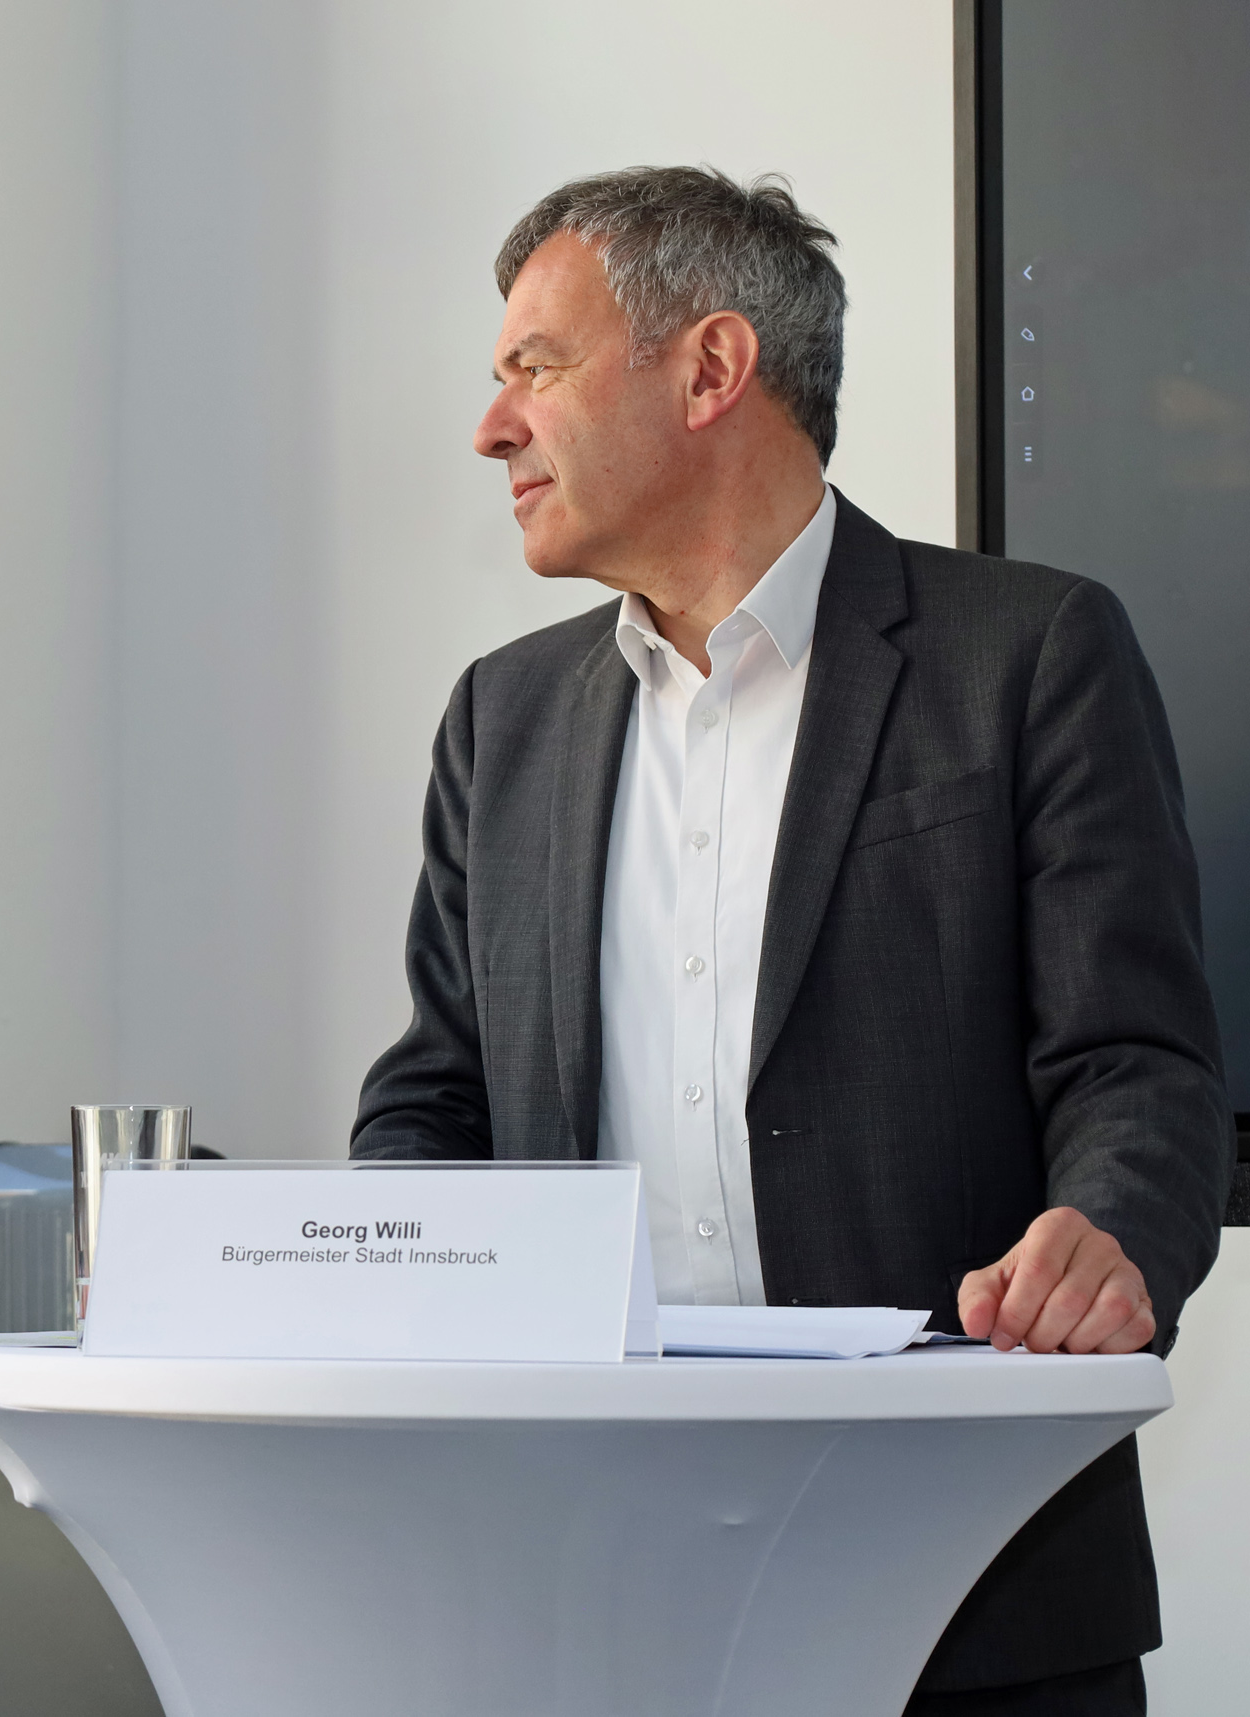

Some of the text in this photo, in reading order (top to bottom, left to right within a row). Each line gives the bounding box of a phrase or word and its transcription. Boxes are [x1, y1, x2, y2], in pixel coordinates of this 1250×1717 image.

[301, 1221, 422, 1243] Georg Willi
[222, 1246, 498, 1266] Bürgermeister Stadt Innsbruck
